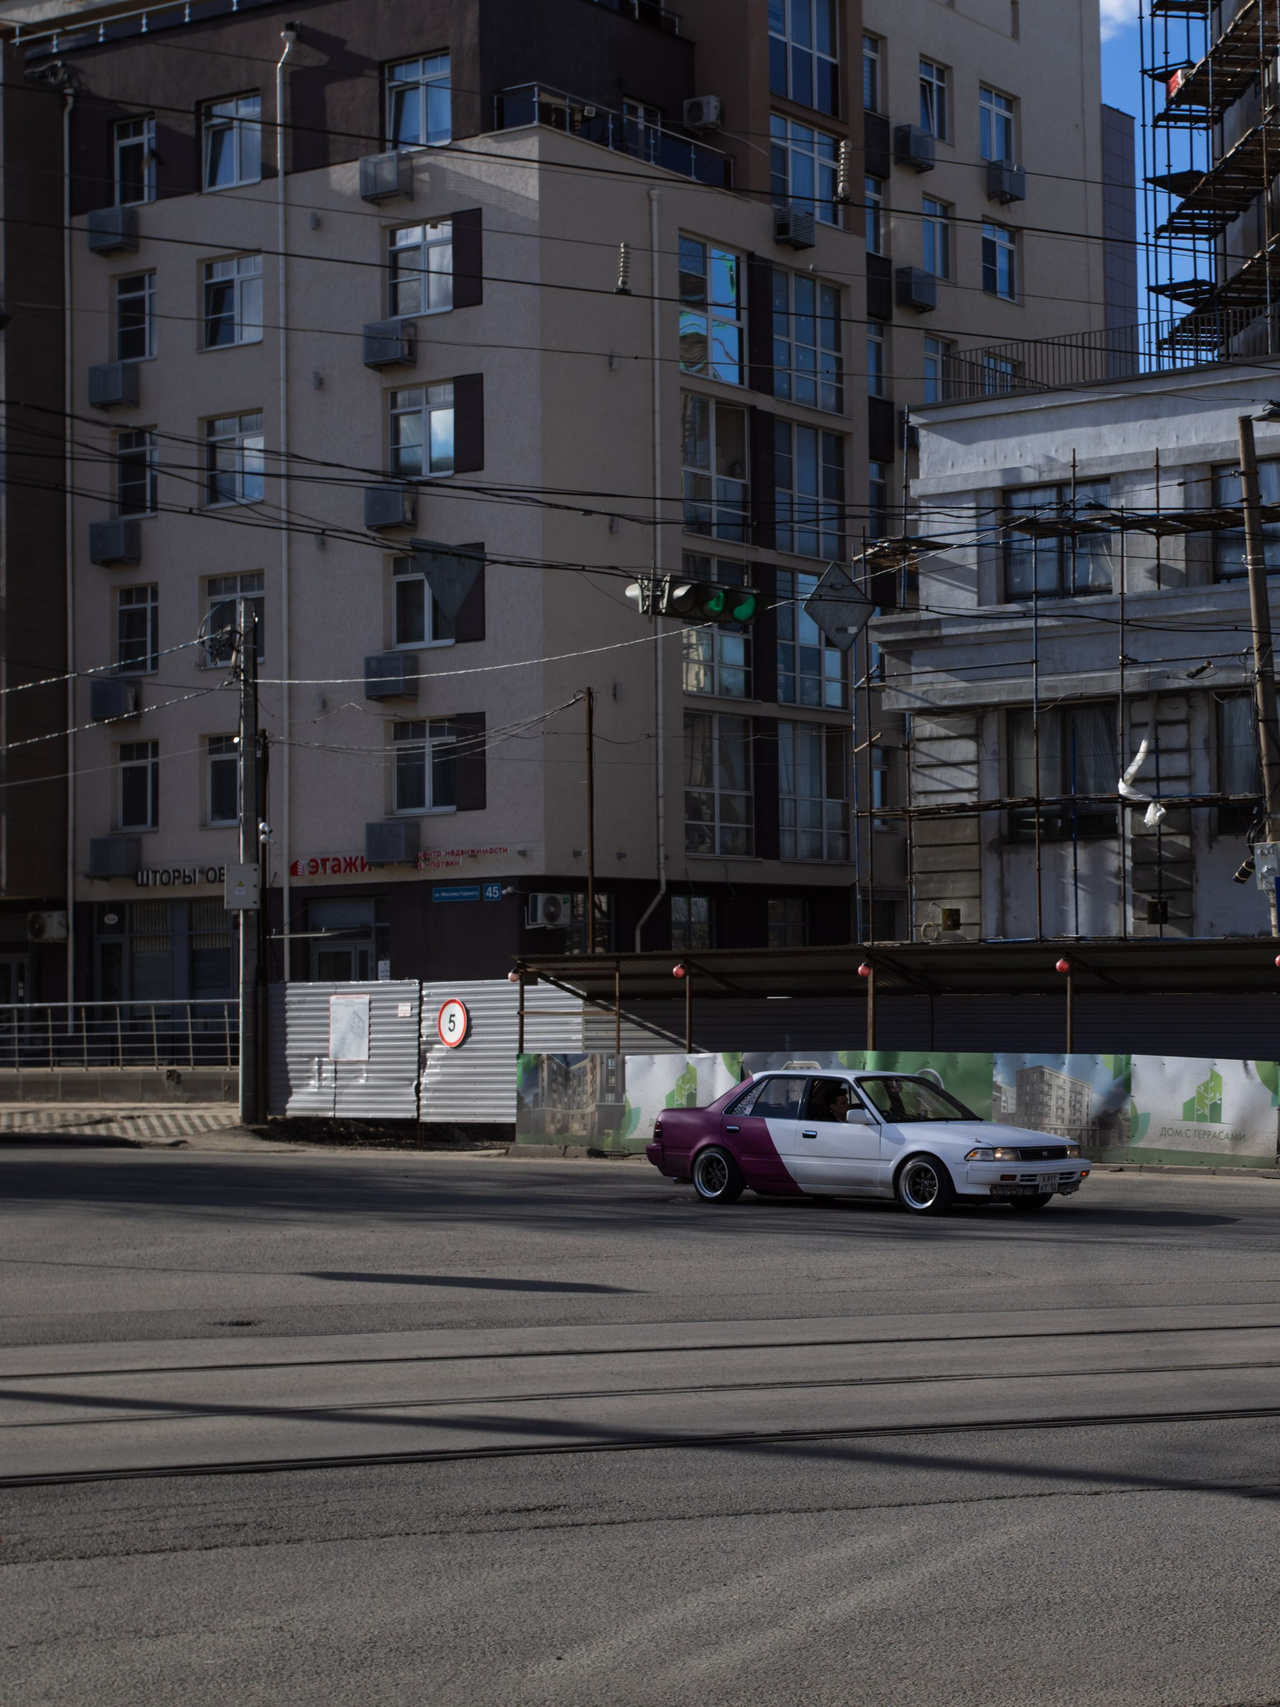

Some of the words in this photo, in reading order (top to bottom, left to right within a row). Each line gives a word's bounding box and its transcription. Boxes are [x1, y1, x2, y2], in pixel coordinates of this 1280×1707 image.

[445, 847, 508, 858] недвижимости
[136, 868, 197, 887] ШТОРЫ
[485, 886, 499, 898] 45
[448, 1014, 456, 1032] 5
[1160, 1127, 1182, 1137] ДОМ
[1185, 1129, 1191, 1138] С
[1193, 1129, 1246, 1141] ТЕРРАСАМИ
